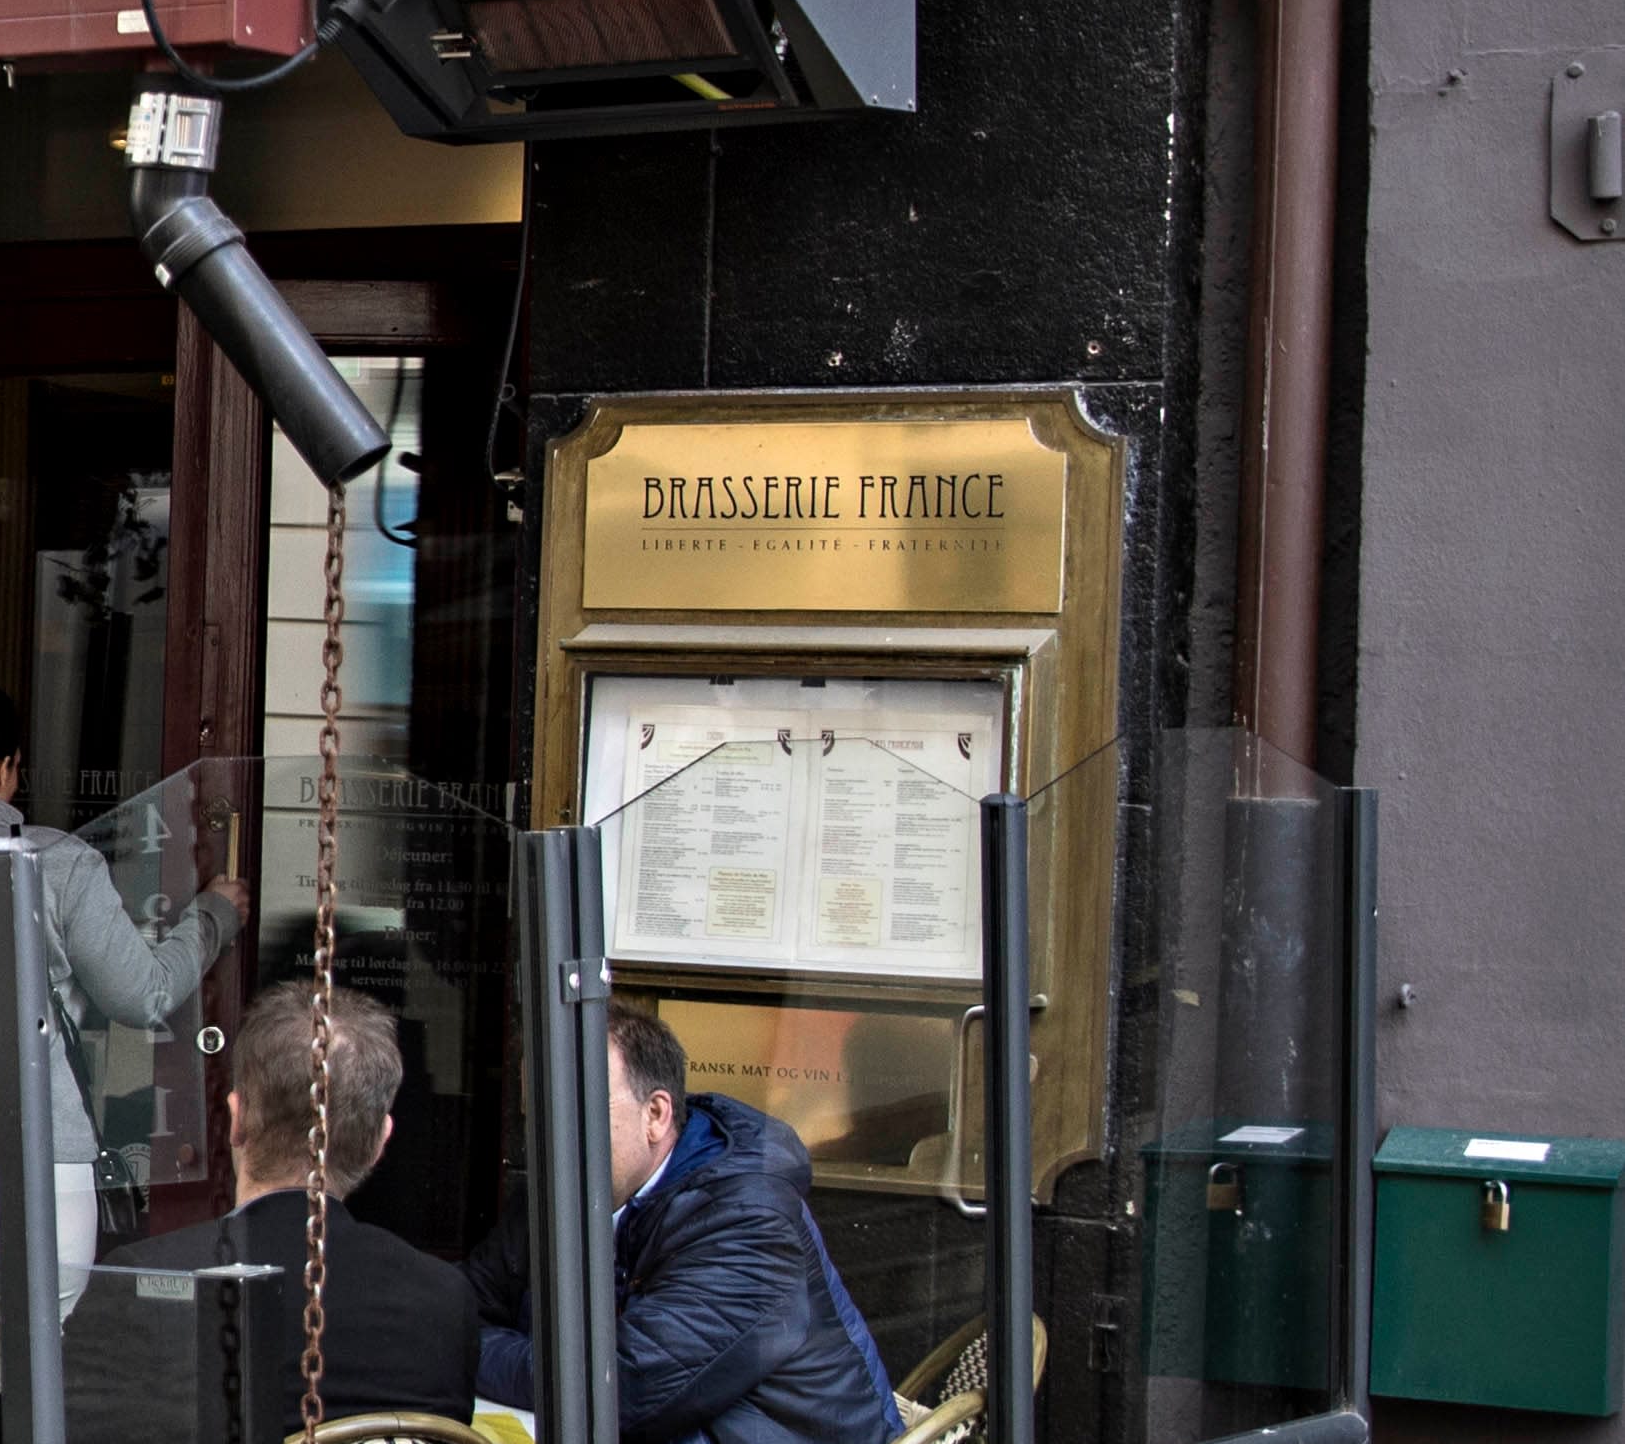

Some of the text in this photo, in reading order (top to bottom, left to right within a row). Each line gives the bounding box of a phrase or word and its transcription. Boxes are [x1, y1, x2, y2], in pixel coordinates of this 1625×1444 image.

[642, 474, 1005, 519] BRASSERIE FRANCE
[741, 1065, 771, 1077] MAT
[777, 1067, 798, 1079] OG
[803, 1069, 829, 1081] VIN
